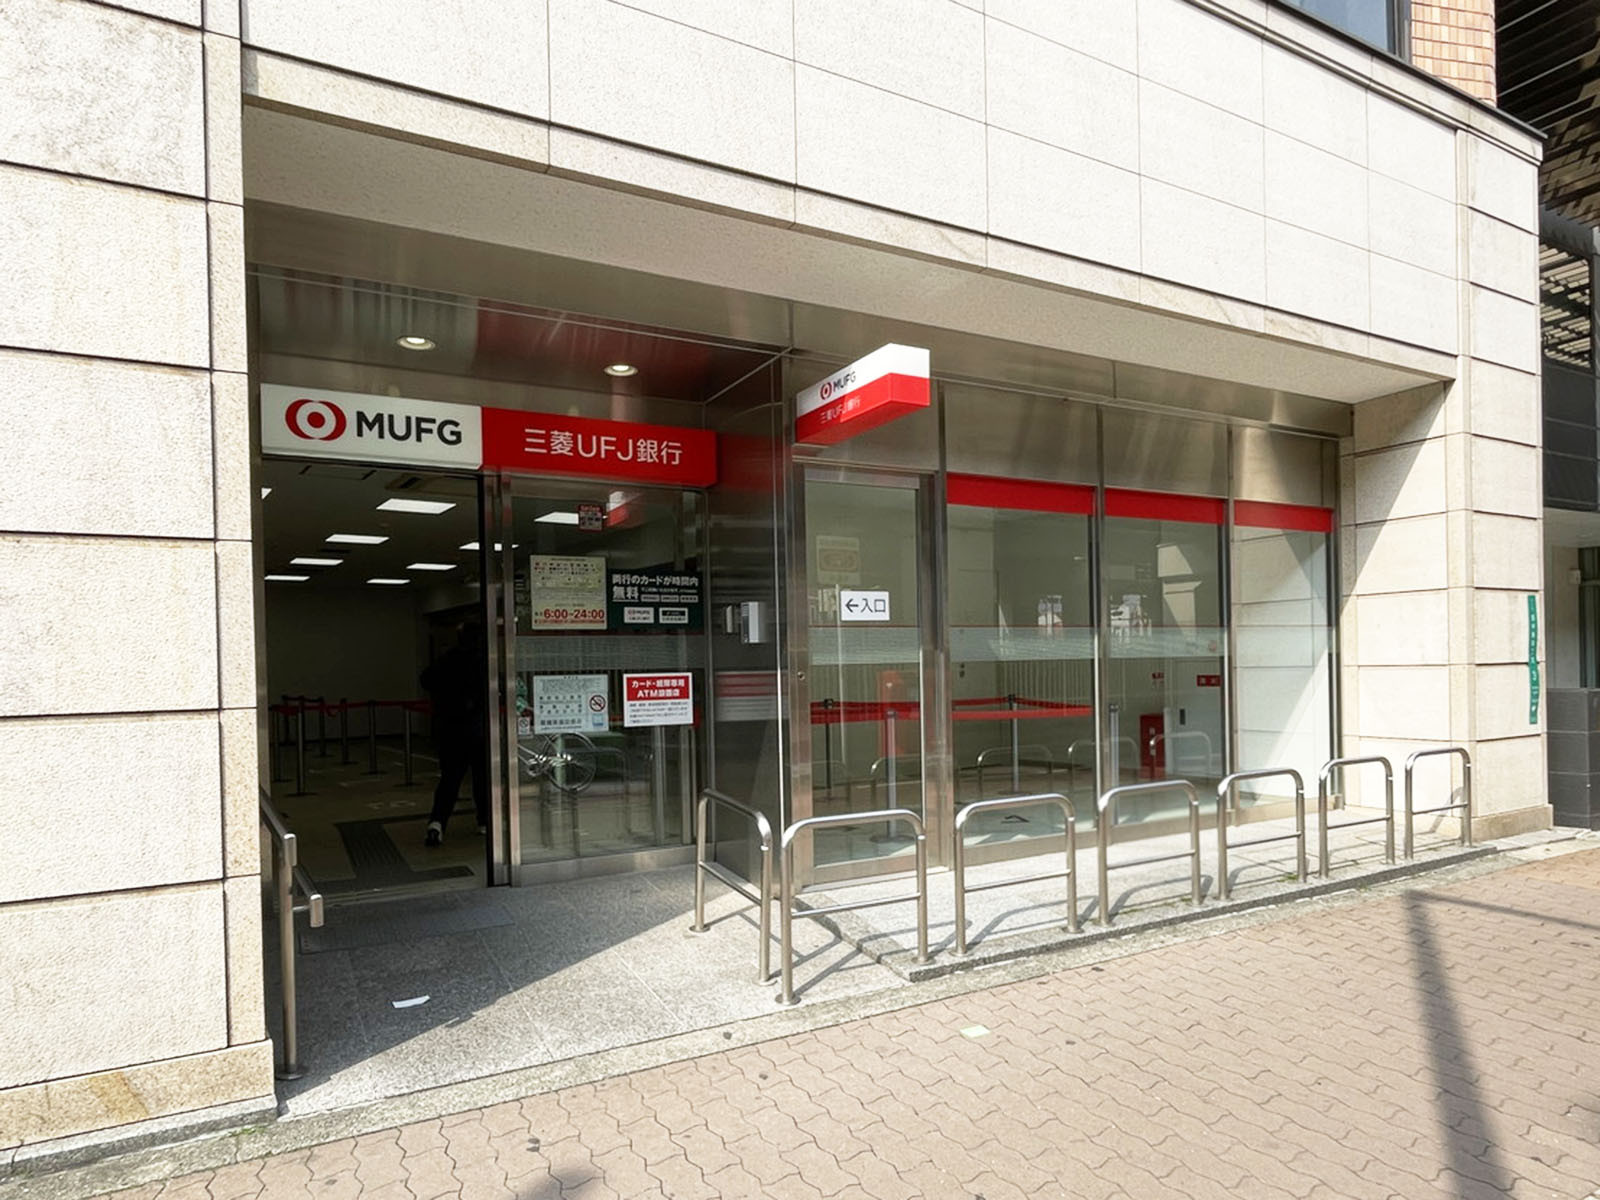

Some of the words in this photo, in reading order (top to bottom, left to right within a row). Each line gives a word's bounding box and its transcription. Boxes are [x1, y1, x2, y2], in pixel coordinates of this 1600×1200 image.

[833, 371, 856, 392] MUFG
[356, 410, 462, 446] MUFG
[524, 428, 683, 466] 三菱UFJ銀行
[861, 597, 886, 613] 入口
